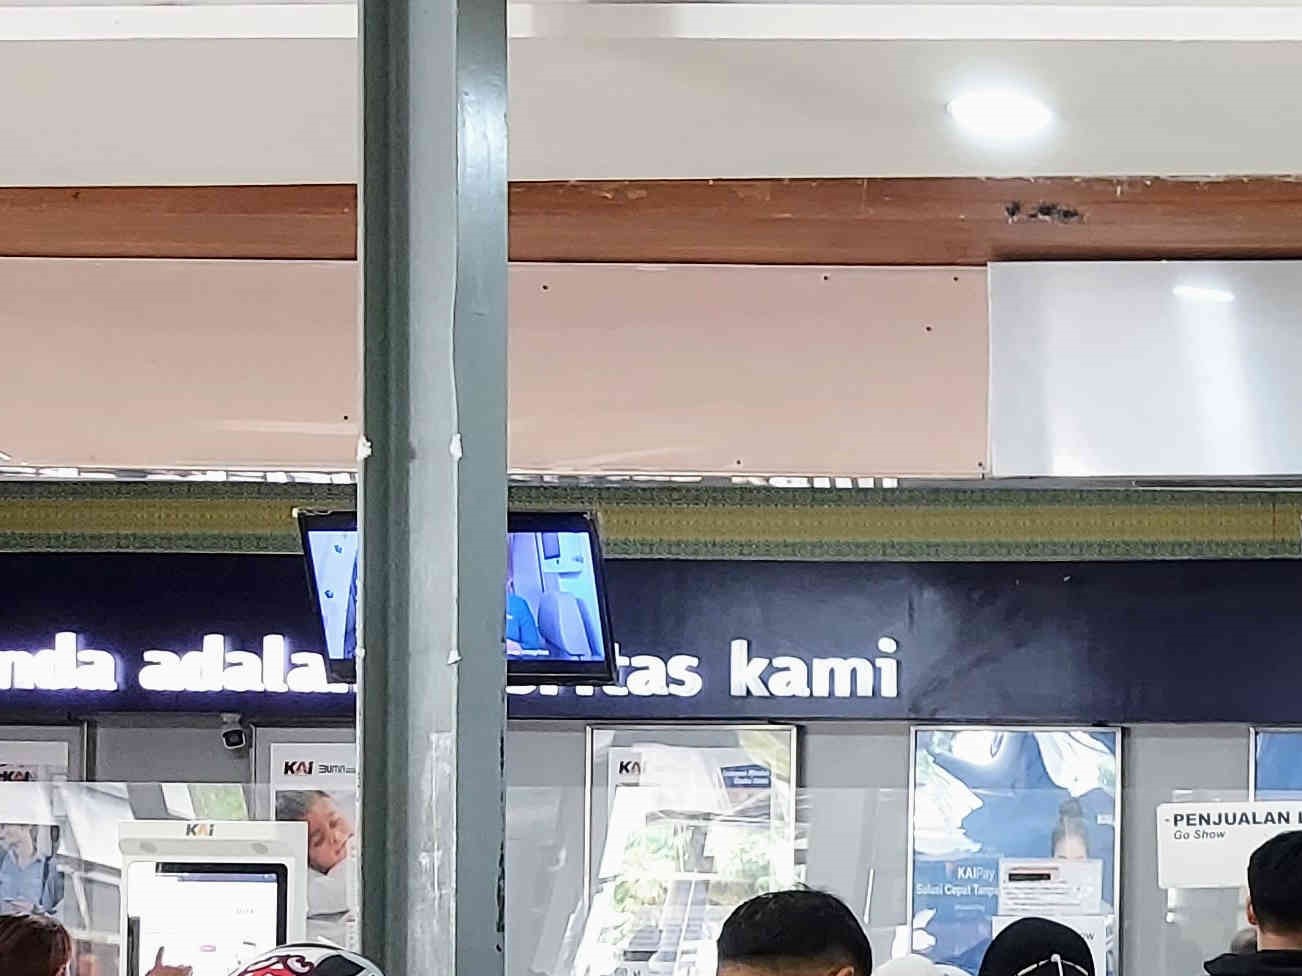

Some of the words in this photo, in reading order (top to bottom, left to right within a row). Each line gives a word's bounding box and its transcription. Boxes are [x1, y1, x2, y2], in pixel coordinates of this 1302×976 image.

[138, 633, 356, 692] adala
[729, 637, 899, 698] kami
[284, 760, 314, 776] KAI
[1173, 811, 1291, 827] PENJUALAN
[1174, 830, 1190, 840] Go
[1194, 829, 1226, 840] Show
